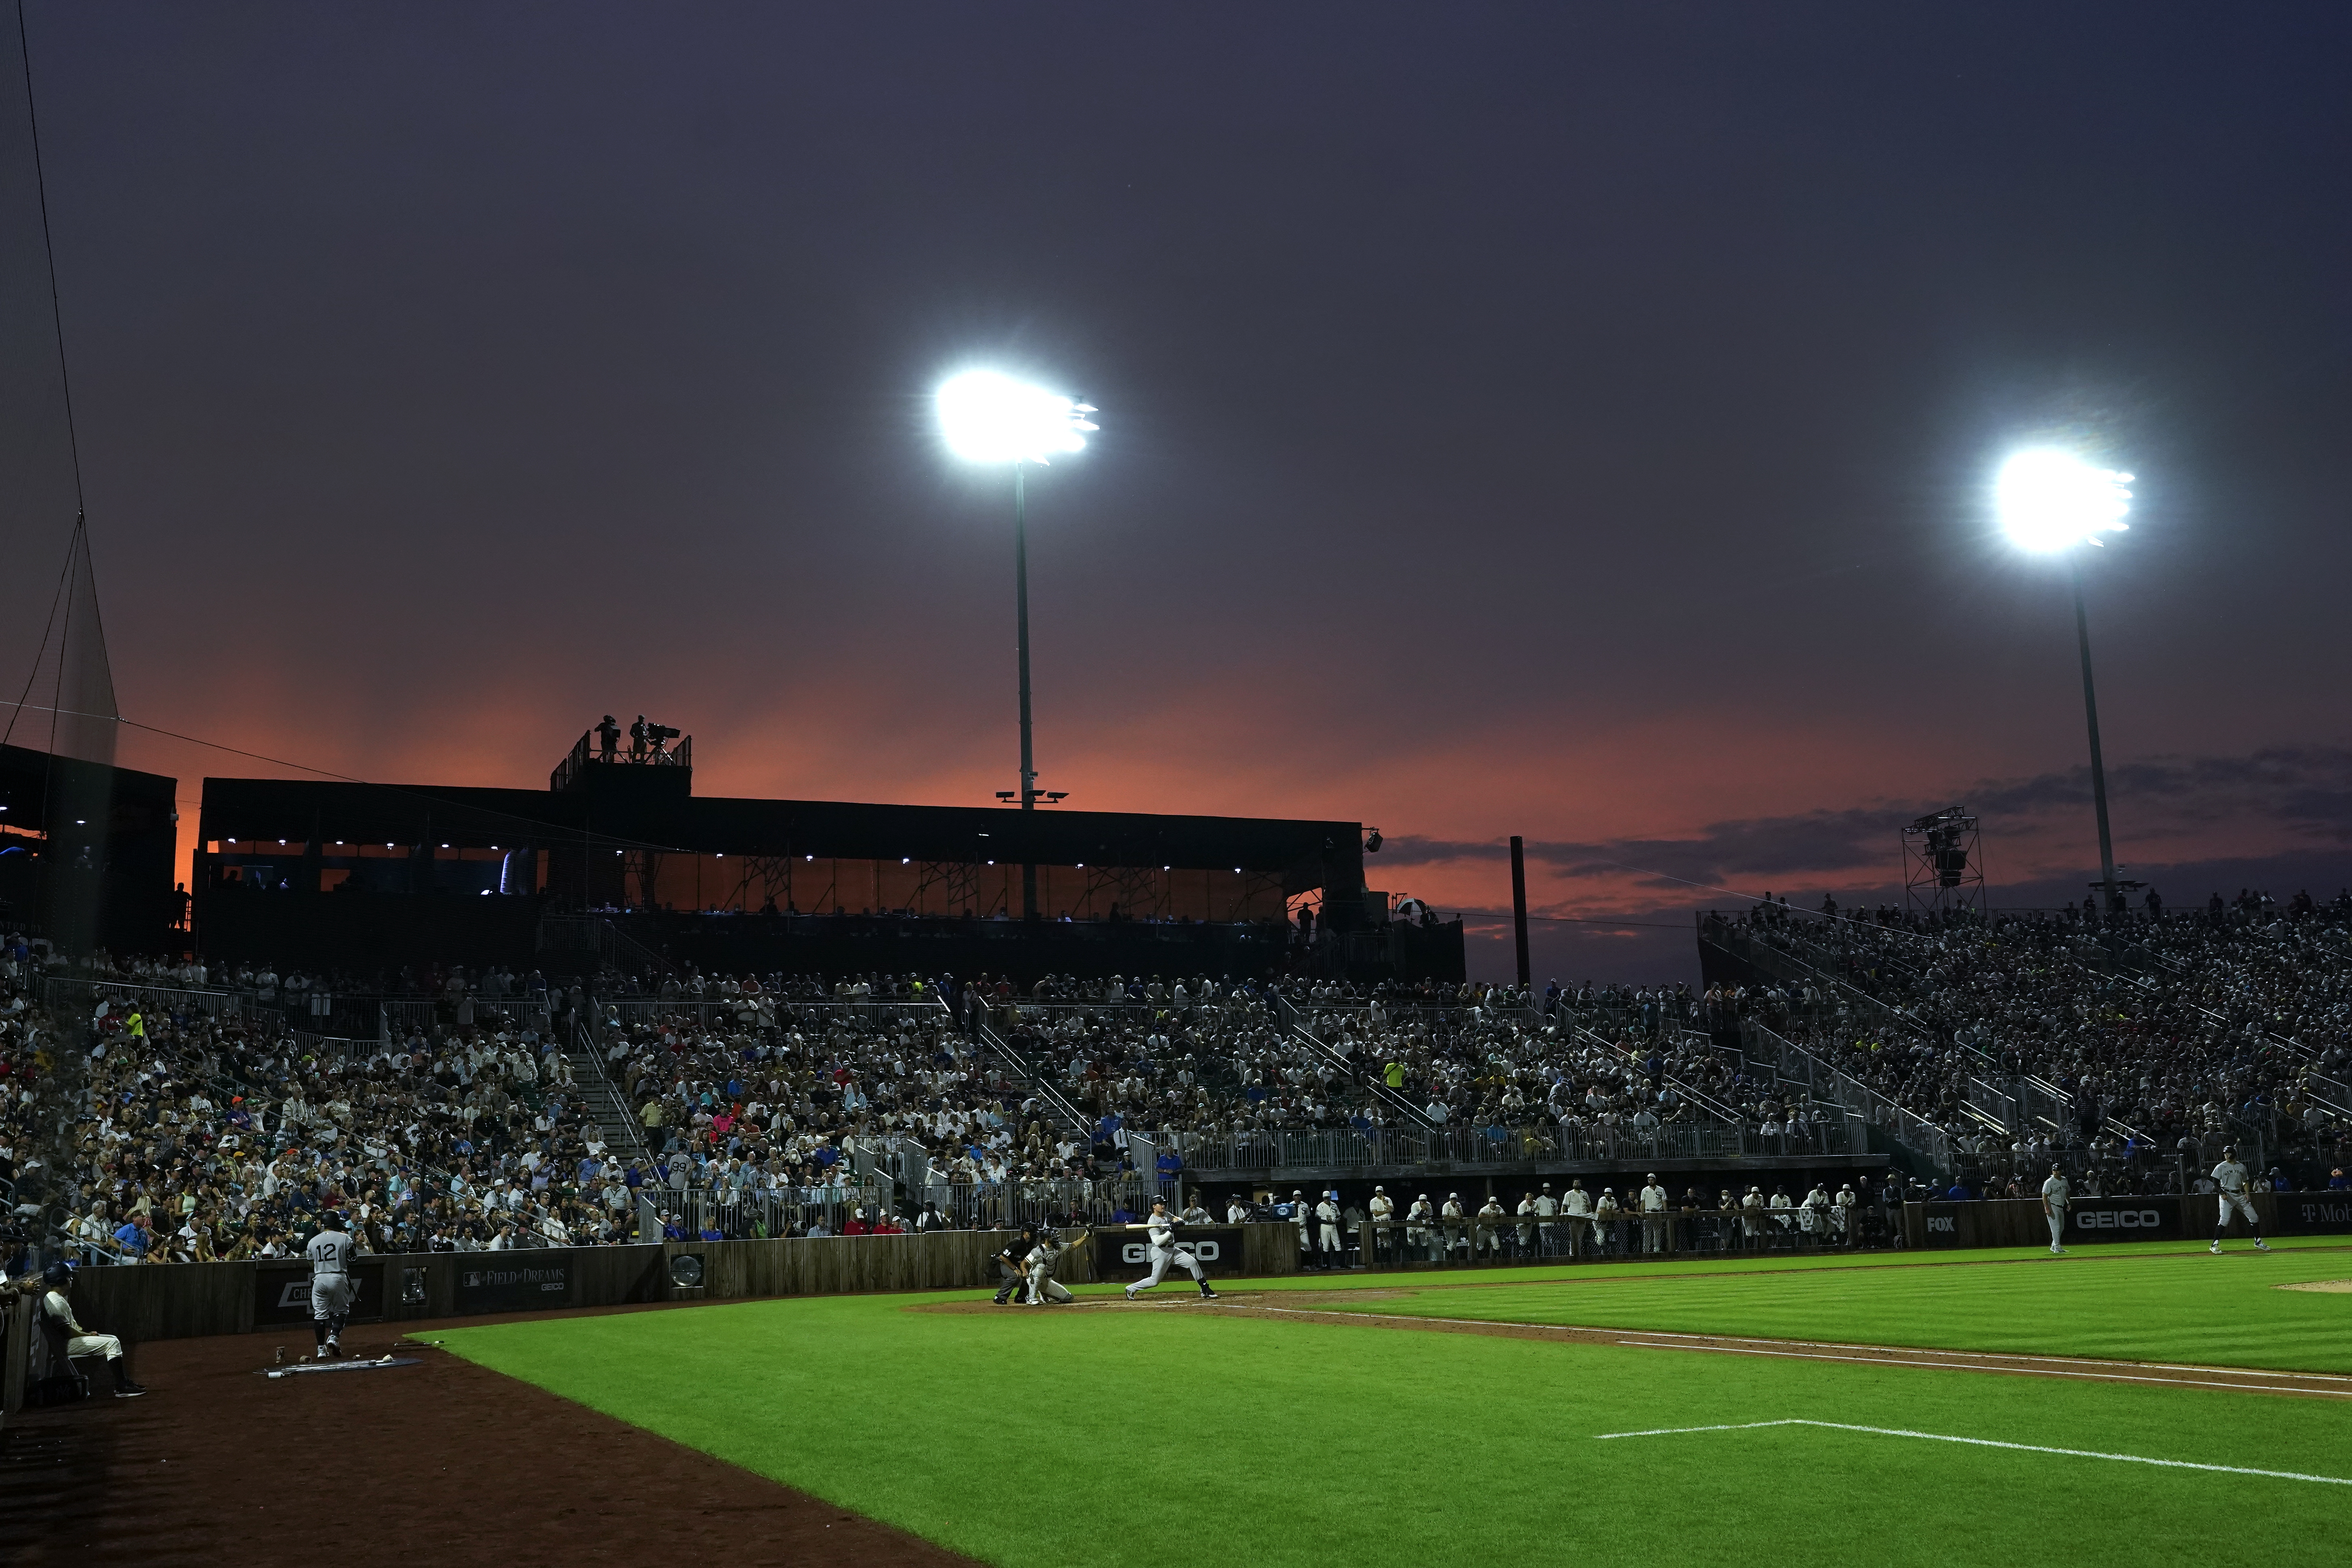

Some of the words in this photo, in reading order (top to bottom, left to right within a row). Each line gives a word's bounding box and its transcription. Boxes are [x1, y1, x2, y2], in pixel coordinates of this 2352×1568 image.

[672, 1162, 686, 1172] 99
[1927, 1217, 1955, 1232] FOX
[2076, 1210, 2160, 1229] GEICO
[316, 1243, 337, 1262] 12
[1122, 1241, 1219, 1264] GCO
[487, 1270, 517, 1285] FIELD
[523, 1268, 564, 1283] DREAMS
[541, 1282, 564, 1291] GEICO
